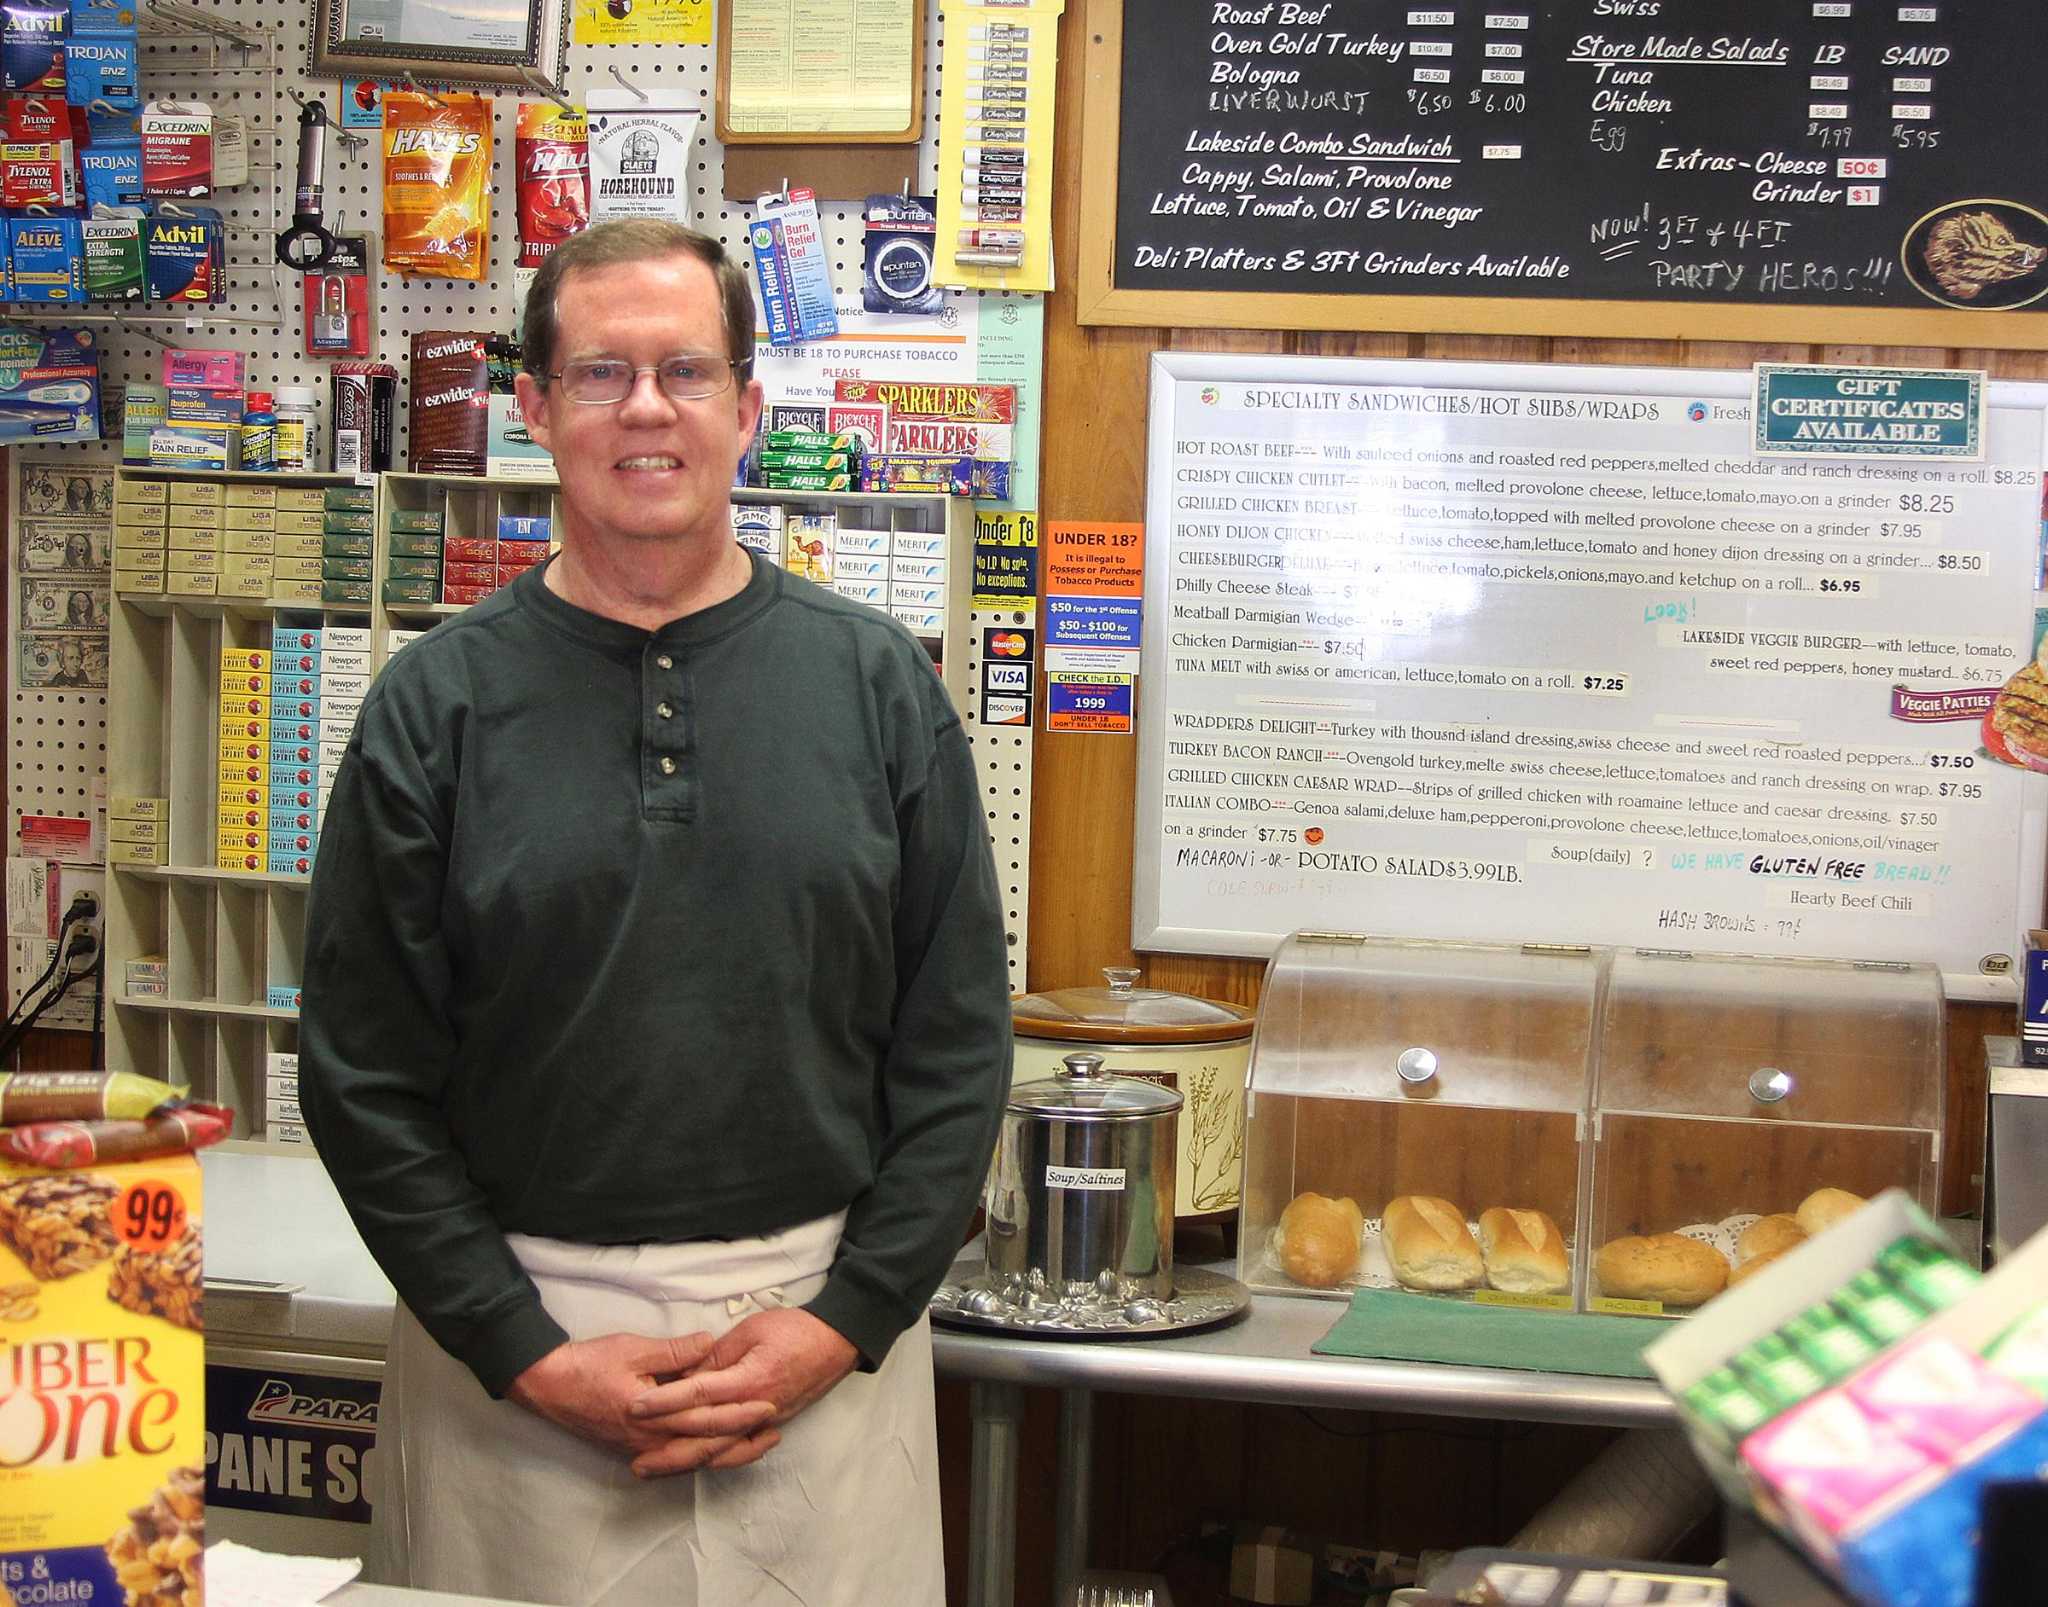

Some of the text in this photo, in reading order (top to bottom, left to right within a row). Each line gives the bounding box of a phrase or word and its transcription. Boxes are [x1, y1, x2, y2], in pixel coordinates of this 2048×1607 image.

[1211, 3, 1332, 26] Roast Beef
[1594, 0, 1658, 16] Swiss
[5, 14, 63, 32] Advil
[1416, 14, 1446, 24] $11.50
[1493, 17, 1518, 27] $7.50
[66, 46, 127, 60] TROJAN
[1211, 30, 1404, 63] Oven Gold Turkey
[1492, 46, 1516, 55] $7.00
[1572, 36, 1949, 65] Store Made Salads LB SAND
[100, 67, 127, 76] ENZ
[1211, 63, 1299, 90] Bologna
[1419, 71, 1445, 80] $6.50
[1490, 72, 1515, 81] $6.00
[1594, 65, 1652, 84] Tuna
[1592, 92, 1671, 113] Chicken
[21, 116, 56, 125] TYLENOL
[146, 122, 209, 133] EXCEDRIN
[147, 137, 190, 145] MIGRAINE
[1590, 120, 1625, 152] Egg
[1186, 131, 1452, 156] Lakeside Combo Sandwich
[83, 156, 137, 168] TROJAN
[1843, 161, 1879, 175] 50¢
[8, 165, 50, 176] TYLENOL
[1183, 165, 1452, 192] Cappy, Salami, Provolone
[601, 178, 674, 194] HOREHOUND
[1752, 181, 1842, 204] Grinder
[1852, 188, 1871, 202] $1
[1150, 195, 1482, 228] Lettuce, Tomato, Oil & Vinegar
[786, 223, 809, 235] Burn
[1590, 202, 1650, 243] NOW!
[85, 227, 136, 237] EXCEDRIN
[151, 225, 206, 243] Advil
[16, 232, 62, 247] ALEVE
[787, 233, 816, 247] Relief
[87, 248, 124, 256] STRENGTH
[789, 246, 807, 258] Gel
[1134, 247, 1569, 278] Deli Platters & 3Ft Grinders Available
[1649, 261, 1743, 289] PARTY
[758, 348, 958, 360] MUST BE 18 TO PURCHASE TOBACCO
[172, 359, 208, 371] Allergy
[822, 369, 861, 378] PLEASE
[786, 386, 812, 396] Have
[1837, 380, 1901, 396] GIFT
[171, 400, 205, 408] Ibuprofen
[878, 384, 980, 416] SPARKLERS
[1244, 391, 1659, 420] SPECIALTY SUBS/WRAPS
[1772, 399, 1964, 419] CERTIFICATES
[778, 412, 822, 431] BICYCLE
[836, 413, 876, 430] BICYCLE
[1794, 422, 1940, 442] AVAILABLE
[794, 436, 830, 445] HALLS
[152, 445, 208, 454] PAIN RELIEF
[786, 456, 822, 466] HALLS
[1500, 452, 1554, 467] roasted
[791, 476, 826, 486] HALLS
[1510, 482, 1954, 512] provolone $8.25
[1880, 523, 1921, 538] $7.95
[840, 536, 869, 546] MERIT
[898, 540, 928, 549] MERIT
[1055, 533, 1137, 546] UNDER 18?
[839, 562, 868, 572] MERIT
[1086, 555, 1113, 565] illegal
[1938, 555, 1981, 569] $8.50
[896, 565, 926, 576] MERIT
[1051, 566, 1085, 574] Possess
[1056, 577, 1134, 586] Tobacco Products
[1820, 579, 1860, 592] $6.95
[895, 590, 925, 600] MERIT
[1051, 603, 1071, 614] $50
[1174, 606, 1229, 620] Meatball
[1059, 621, 1115, 632] $50 $100
[329, 633, 362, 643] Newport
[1056, 632, 1131, 641] Subsequent Offenses
[1172, 634, 1226, 648] Chicken
[1751, 633, 1798, 646] VEGGIE
[328, 656, 362, 666] Newport
[992, 671, 1024, 683] VISA
[1175, 659, 1623, 690] TUNA MELT $7.25
[989, 704, 1023, 713] DISCOVER
[1075, 698, 1106, 709] 1999
[1900, 695, 1991, 711] VEGGIE PATTIES
[1930, 755, 1974, 768] $7.50
[1169, 742, 1982, 798] TURKEY BACON dressing $7.95
[1165, 795, 1210, 809] ITALIAN
[1168, 769, 1937, 826] GRILLED CHICKEN CAESAR grilled chicken with $7.50
[1198, 825, 1297, 842] grinder $7.75
[1298, 852, 1377, 872] POTATO
[1750, 855, 1866, 880] GLUTEN FREE
[1791, 891, 1912, 911] Hearty Beef Chili
[1048, 1169, 1124, 1188] Soup/Saltines
